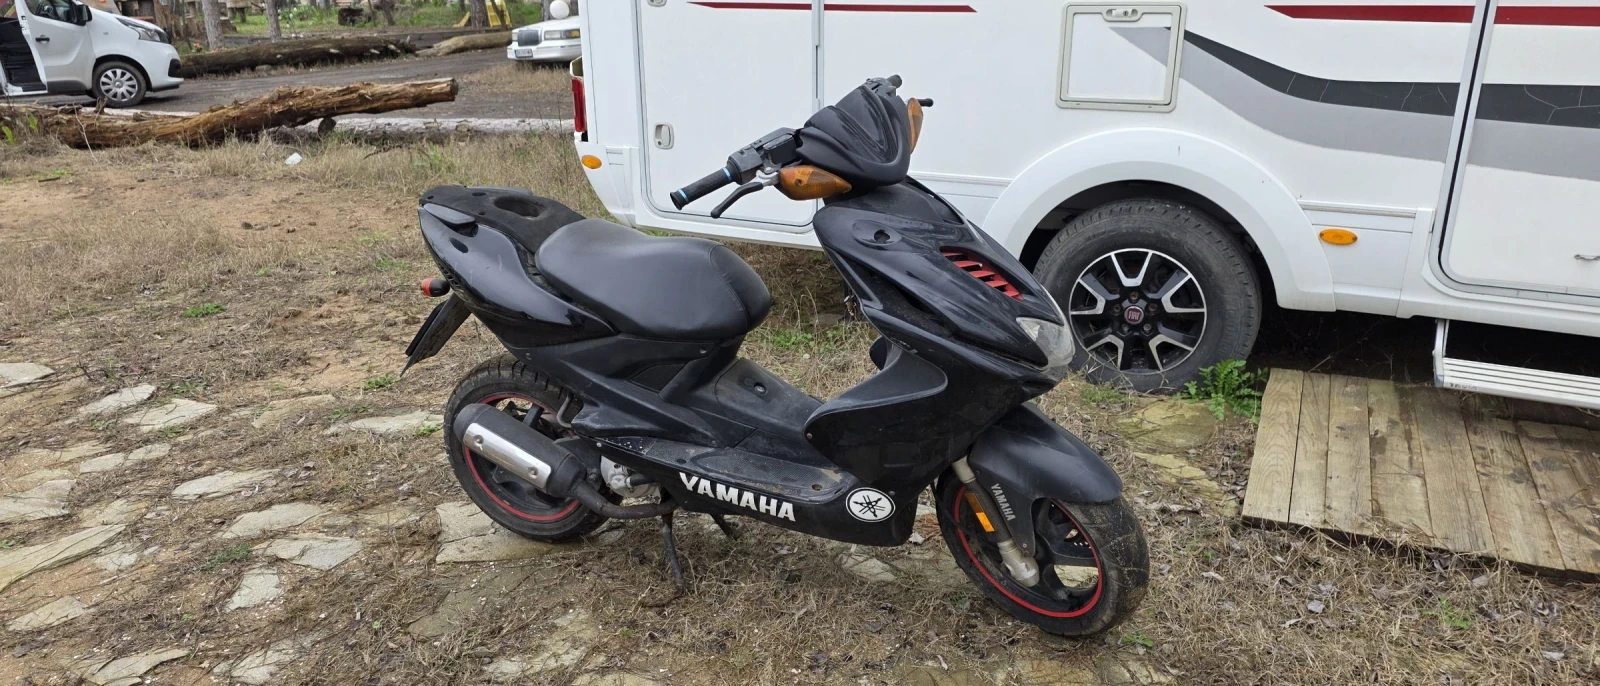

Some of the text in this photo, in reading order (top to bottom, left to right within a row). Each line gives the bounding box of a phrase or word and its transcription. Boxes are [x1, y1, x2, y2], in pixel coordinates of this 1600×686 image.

[1128, 310, 1141, 321] FIAT
[679, 472, 796, 522] YAMAHA
[991, 483, 1016, 521] YAMAHA
